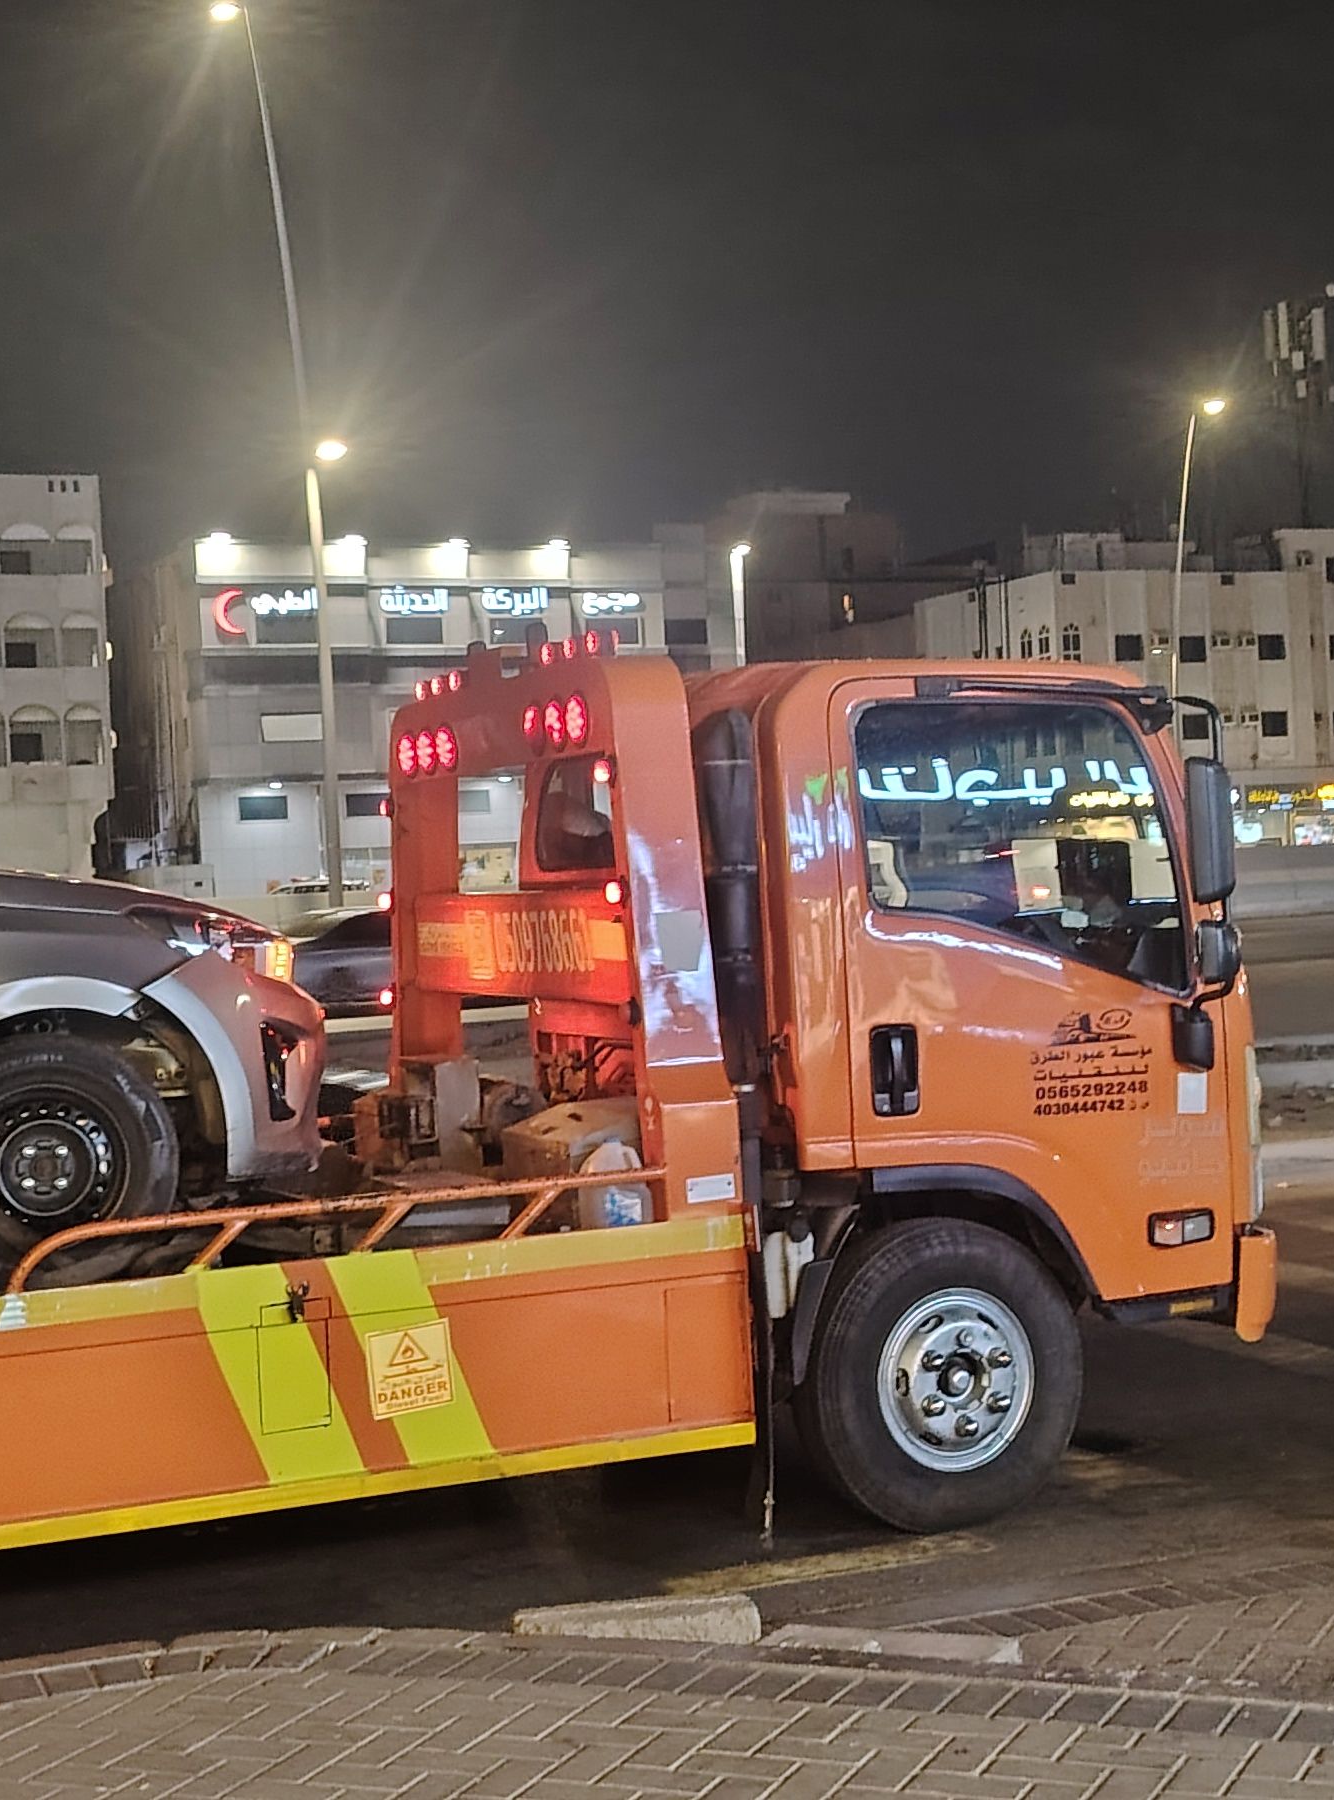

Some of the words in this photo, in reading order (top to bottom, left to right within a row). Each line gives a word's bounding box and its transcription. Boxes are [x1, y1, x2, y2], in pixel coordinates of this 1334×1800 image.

[251, 588, 319, 616] الطبي
[380, 584, 448, 615] الحديثة
[482, 586, 549, 616] البركة
[581, 590, 643, 614] مجمع
[1110, 1045, 1153, 1059] مؤسسة
[377, 1380, 449, 1405] DANGER
